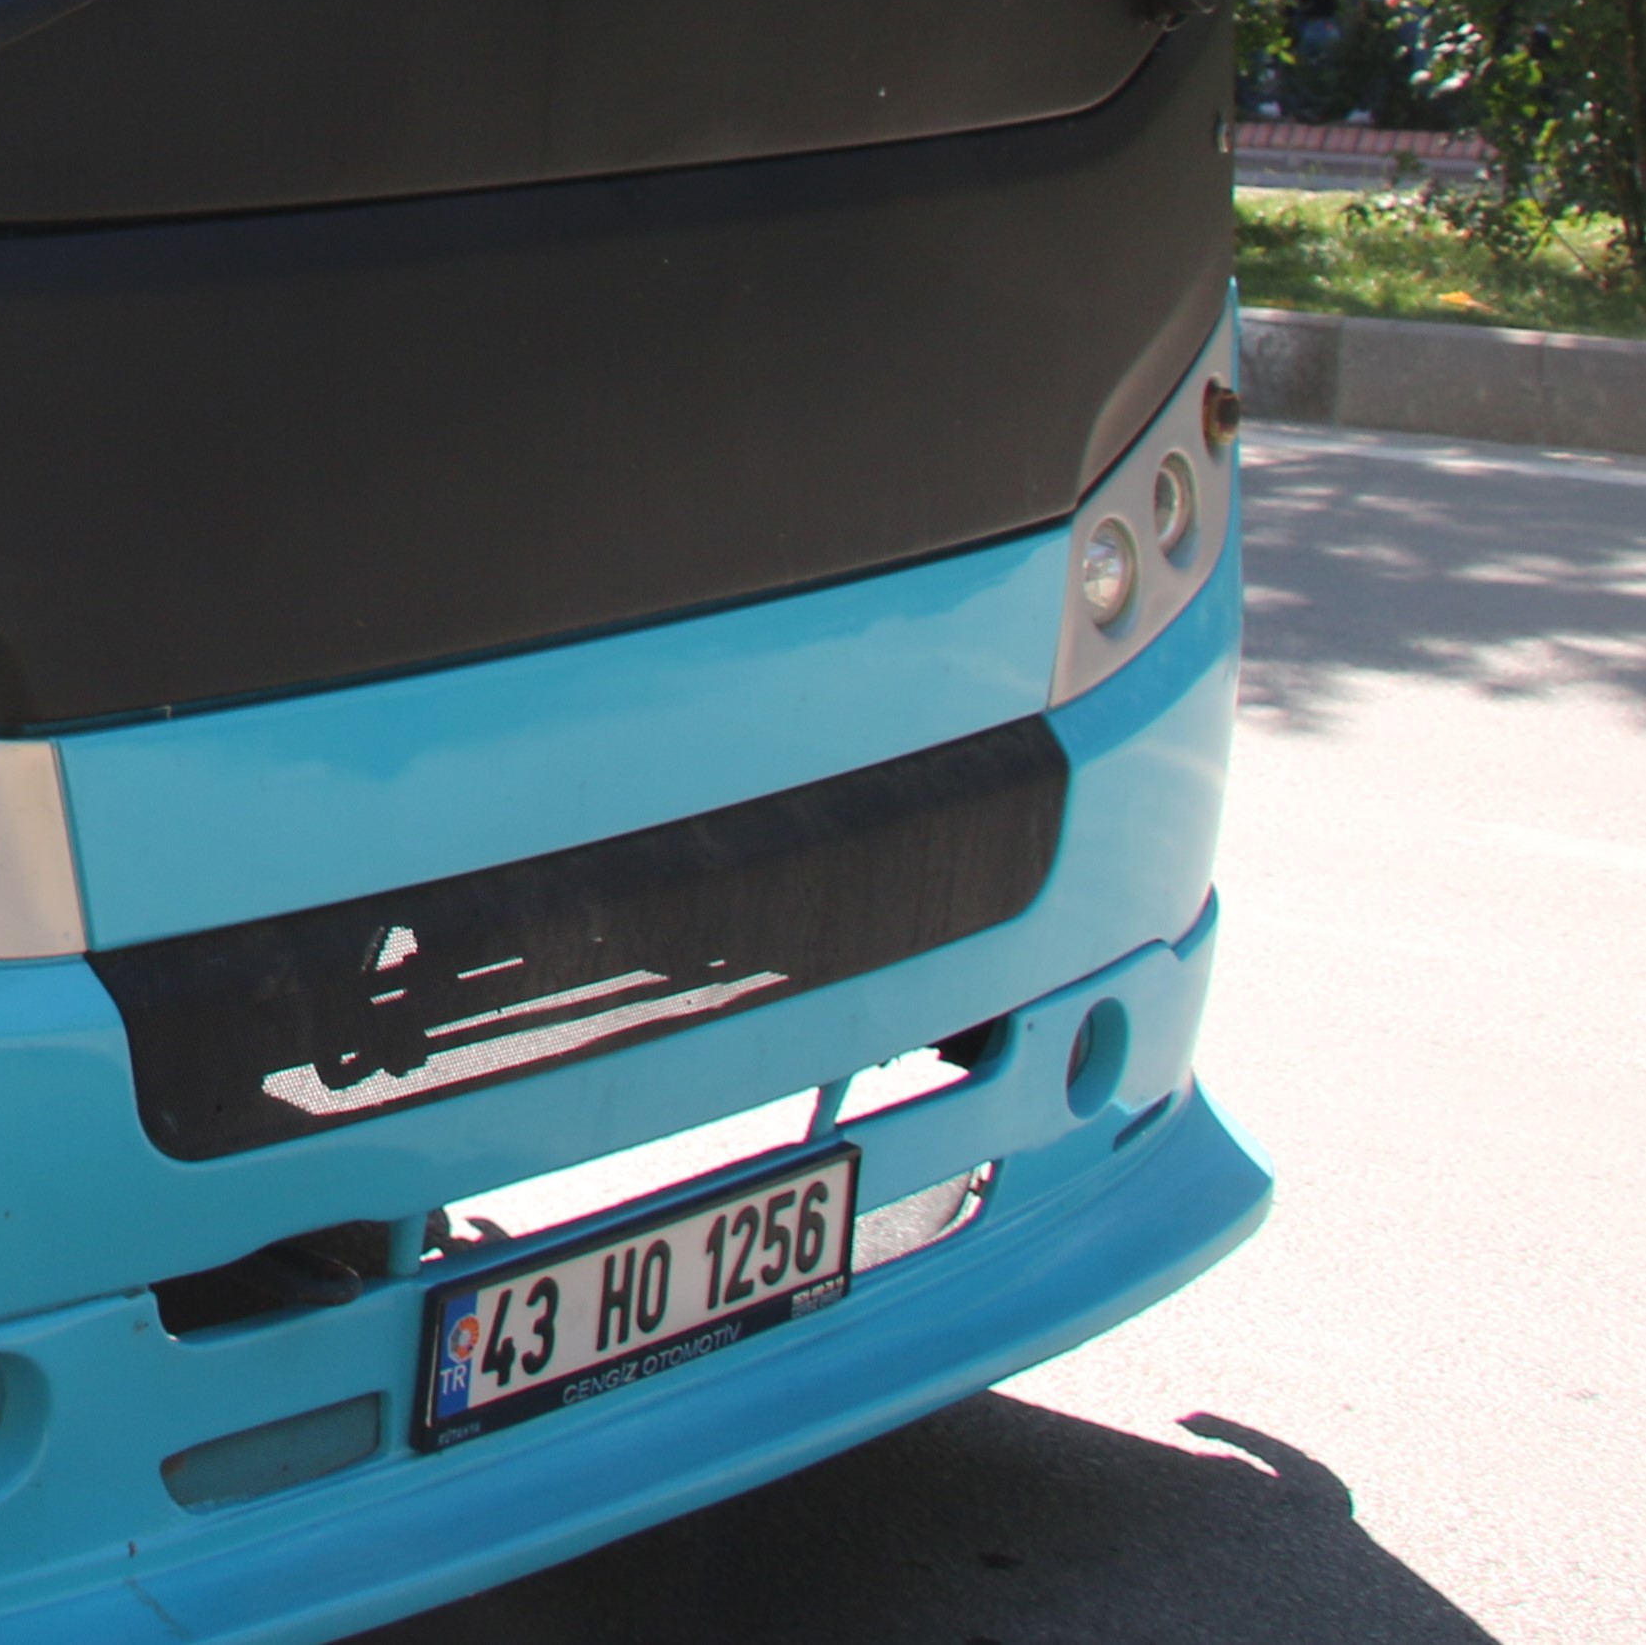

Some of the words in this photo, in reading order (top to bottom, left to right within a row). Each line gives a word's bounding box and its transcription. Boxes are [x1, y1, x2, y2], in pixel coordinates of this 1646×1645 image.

[481, 1276, 559, 1387] 43
[705, 1180, 829, 1311] 1256
[440, 1363, 468, 1395] TR
[563, 1360, 640, 1405] CENGİZ
[641, 1320, 743, 1376] OTOMOTİV
